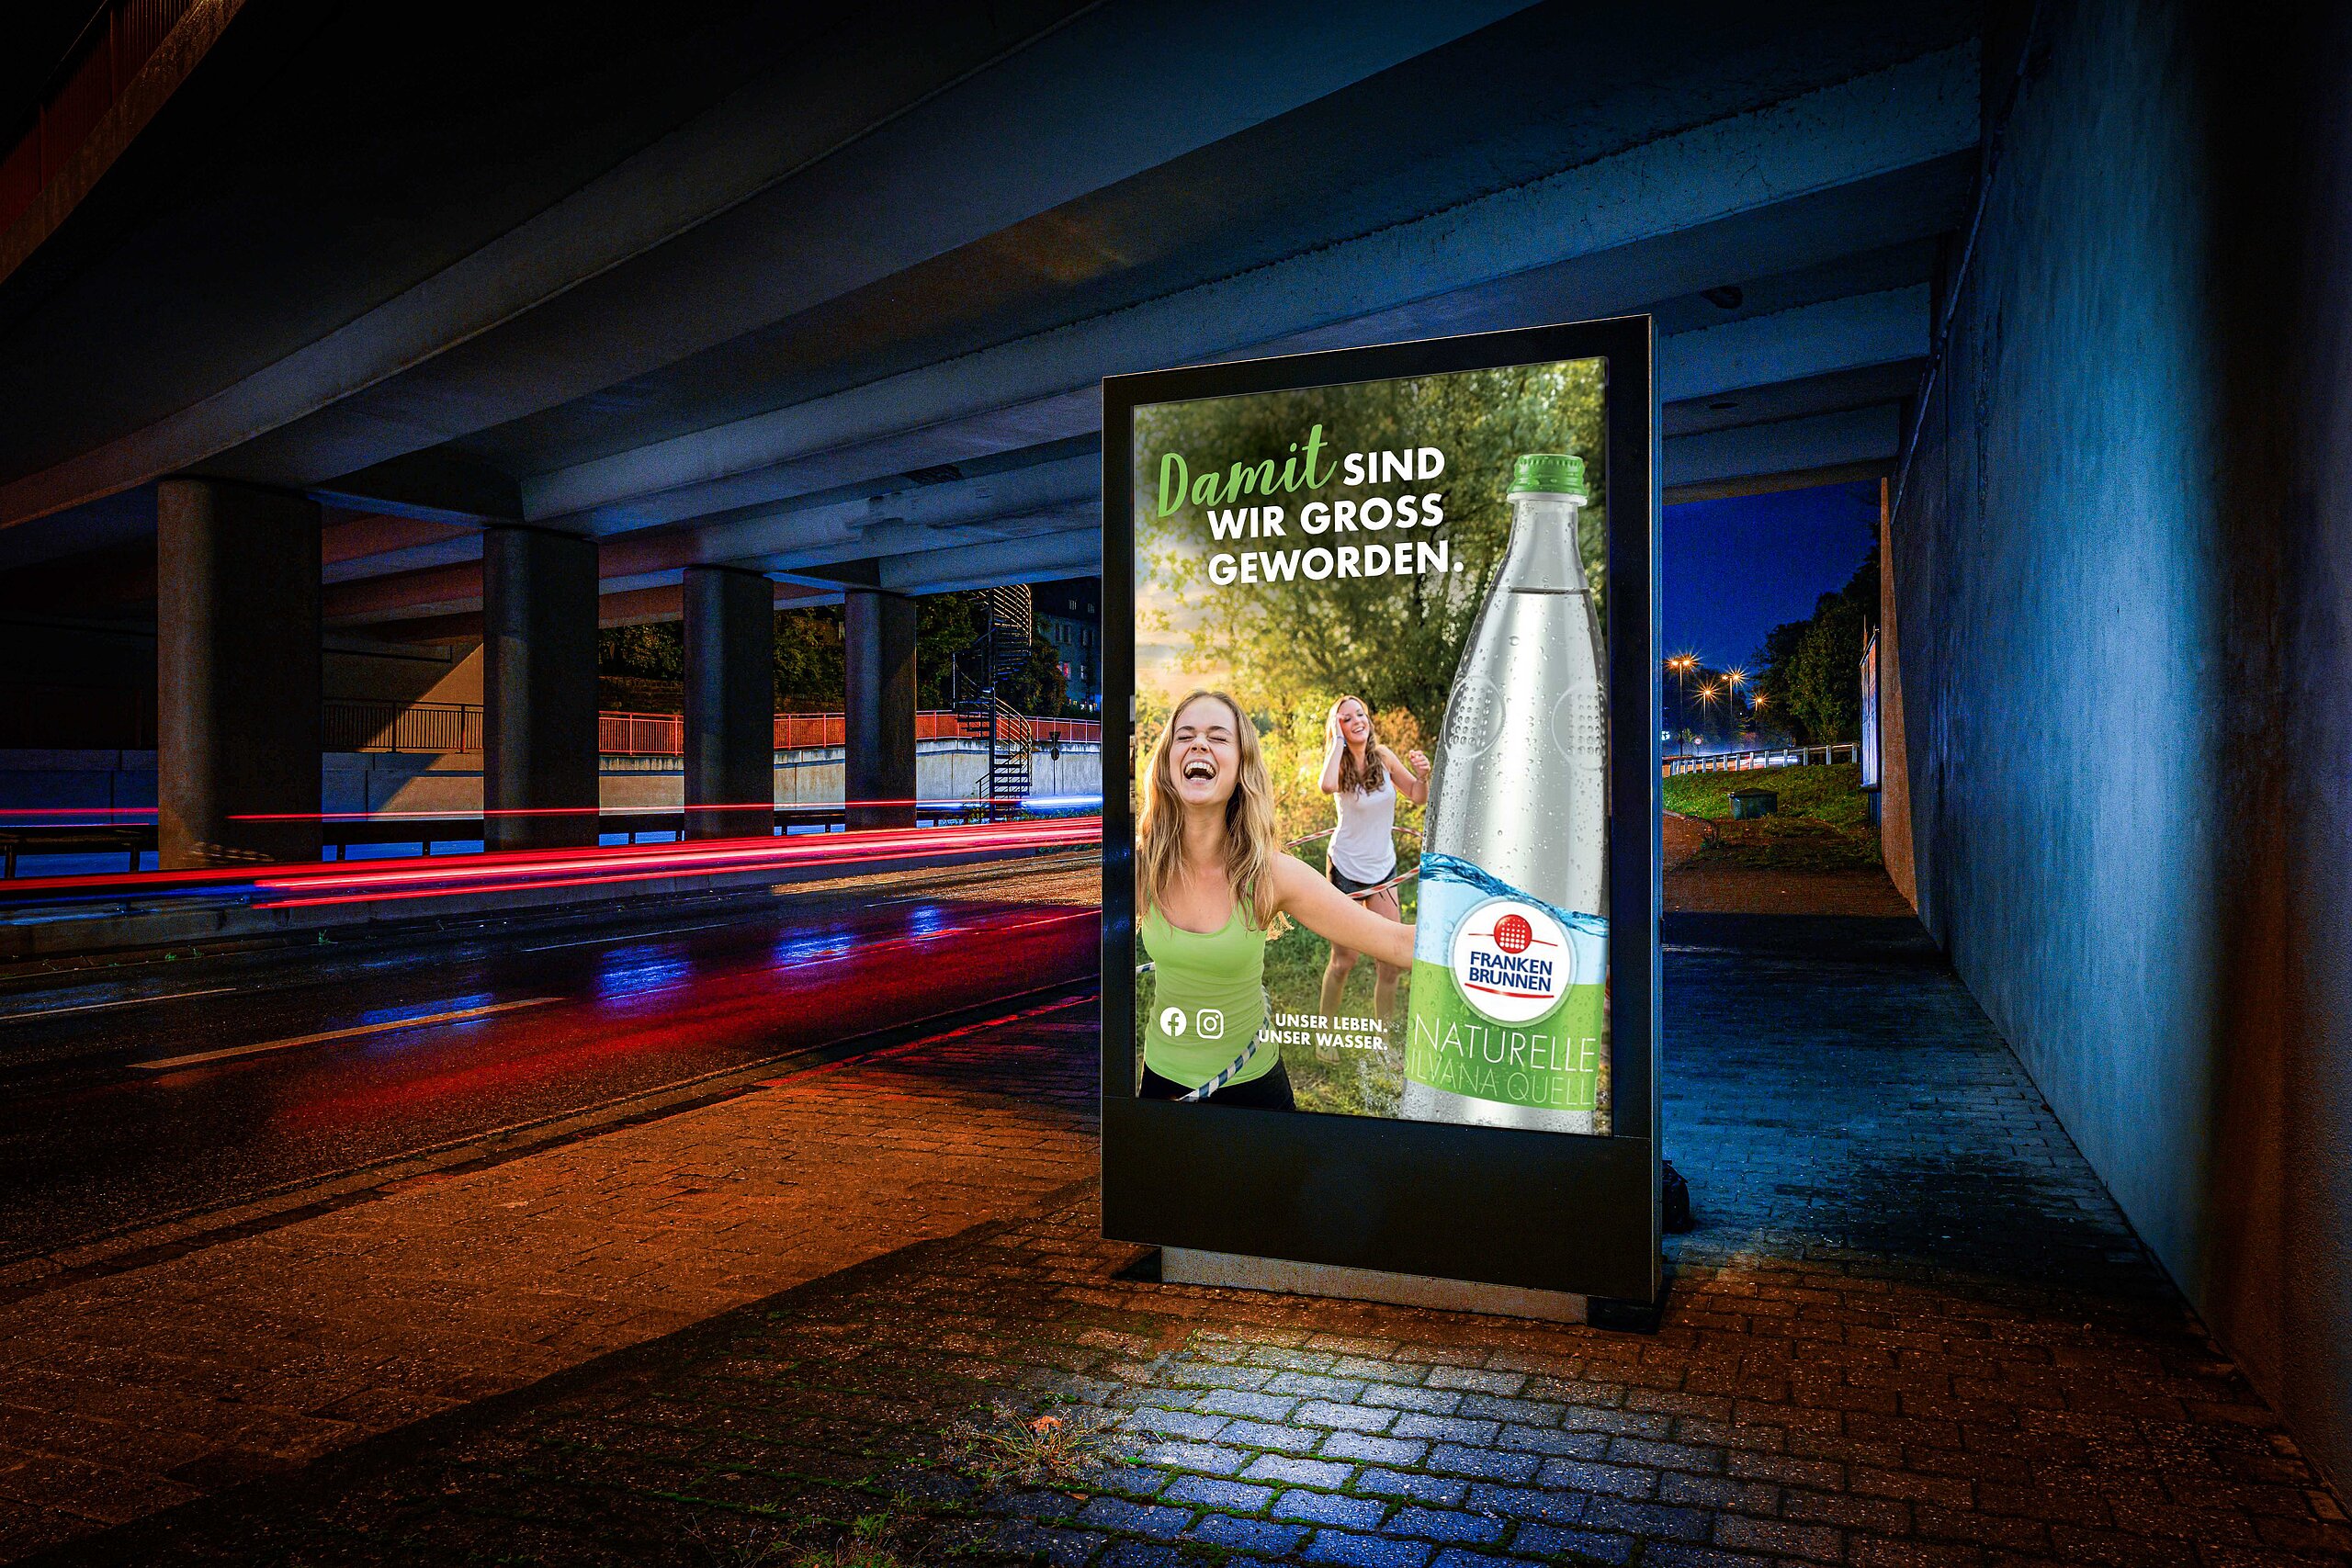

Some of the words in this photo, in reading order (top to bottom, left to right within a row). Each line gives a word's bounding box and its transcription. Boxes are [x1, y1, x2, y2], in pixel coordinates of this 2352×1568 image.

[1158, 423, 1338, 518] Damit
[1342, 446, 1446, 487] SIND
[1206, 505, 1287, 540] WIR
[1300, 492, 1445, 535] GROSS
[1208, 540, 1464, 586] GEWORDEN.
[1469, 967, 1552, 992] BRUNNEN
[1470, 951, 1553, 976] FRANKEN
[1275, 1012, 1329, 1030] UNSER
[1333, 1016, 1388, 1033] LEBEN.
[1258, 1030, 1311, 1046] UNSER
[1315, 1032, 1388, 1051] WASSER.
[1414, 1013, 1597, 1073] NATURELLE
